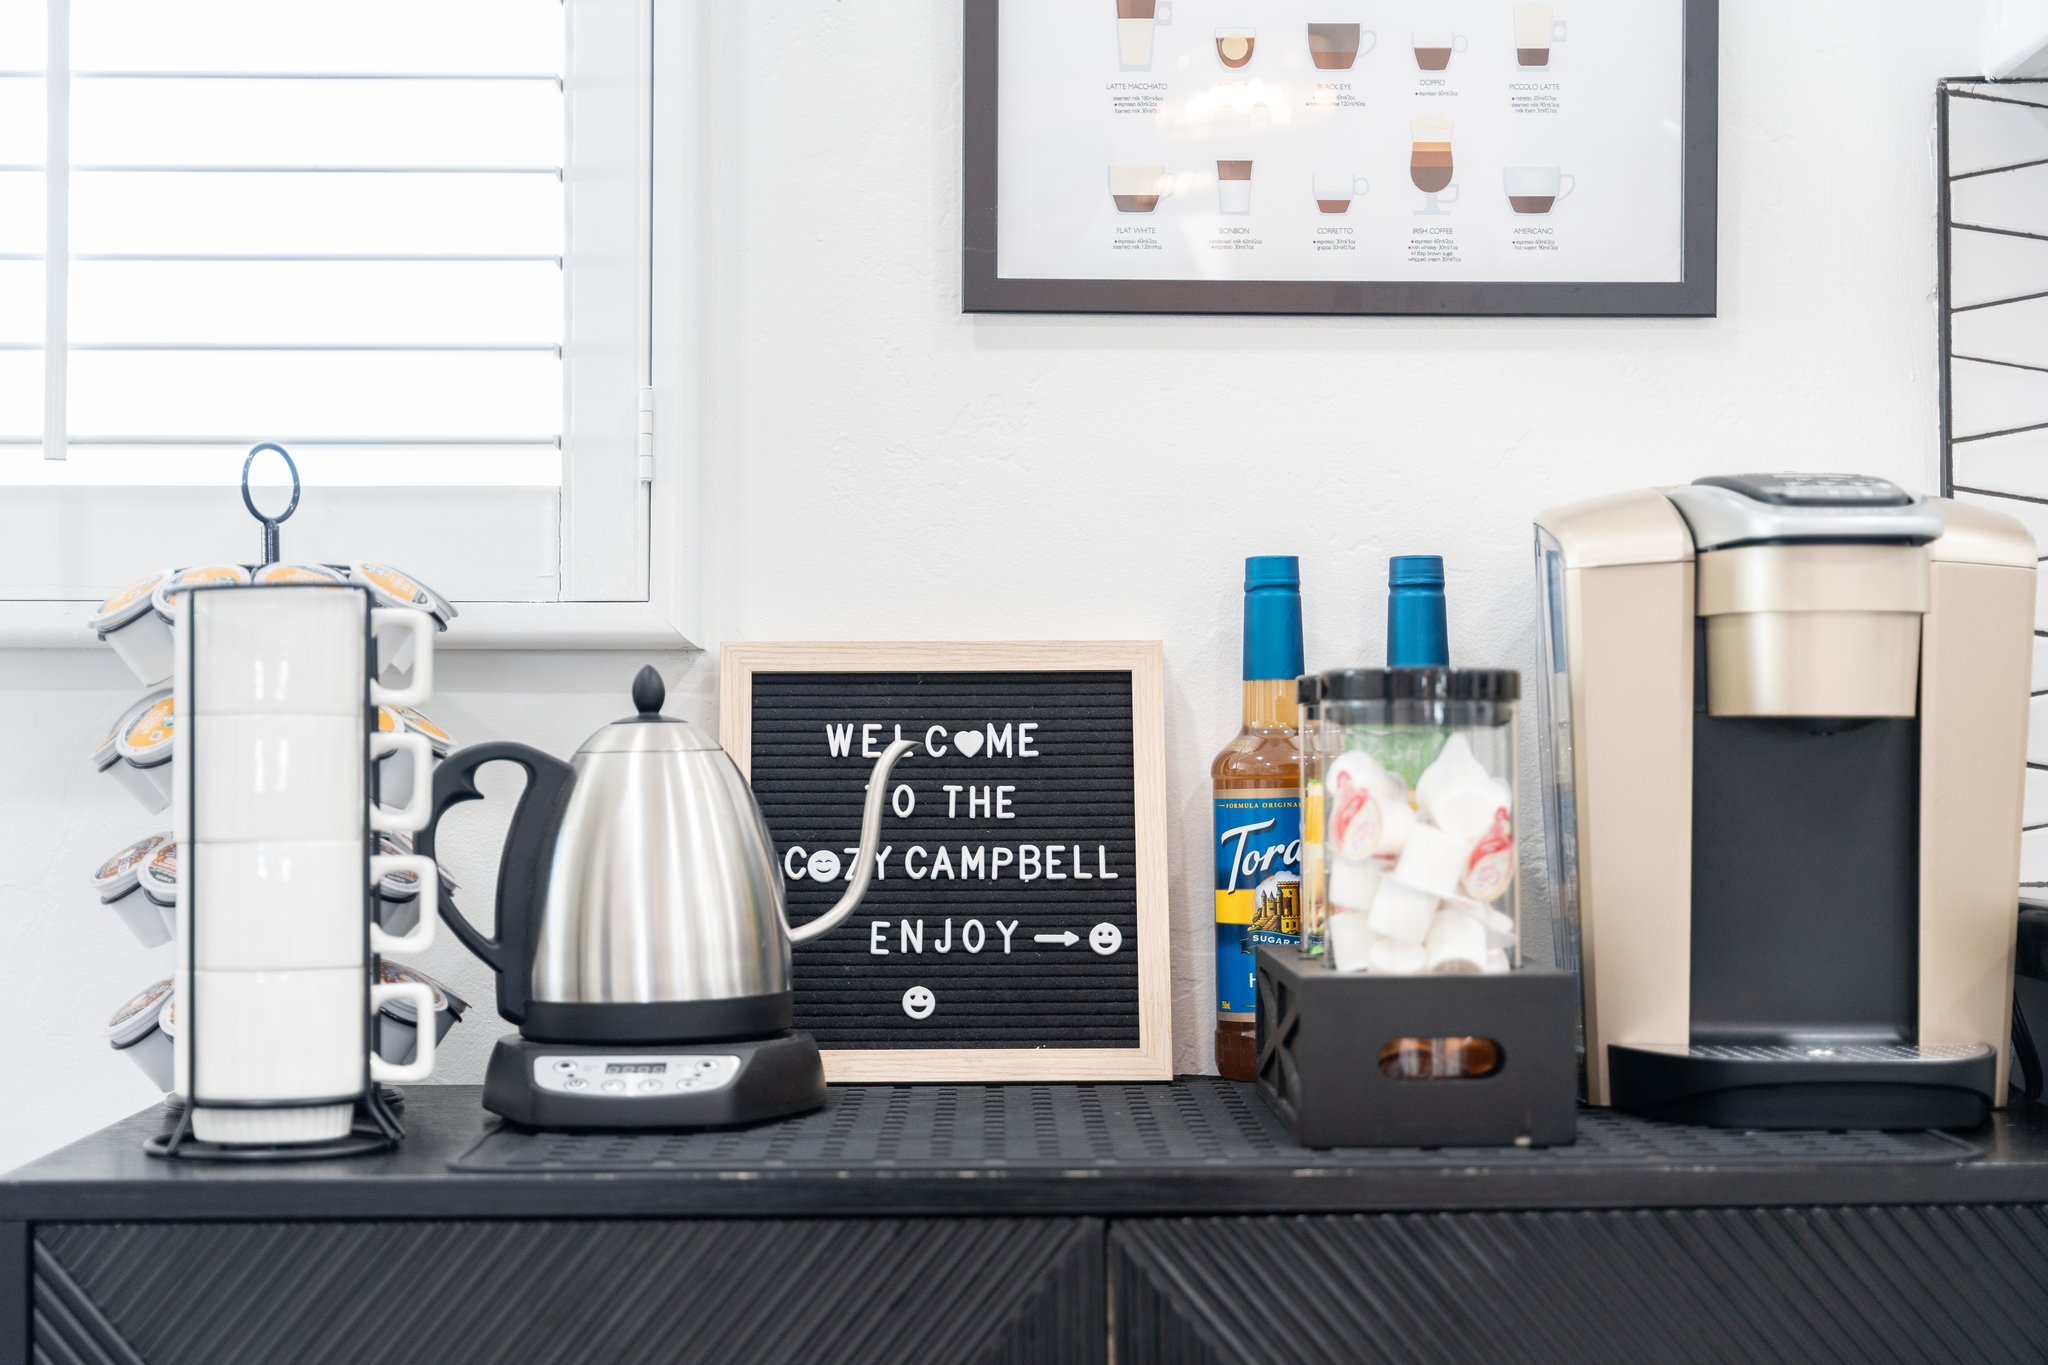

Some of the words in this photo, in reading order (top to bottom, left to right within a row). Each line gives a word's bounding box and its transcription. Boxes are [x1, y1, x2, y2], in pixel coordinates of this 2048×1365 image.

[864, 783, 916, 819] O
[942, 784, 1016, 819] THE
[904, 844, 1119, 881] CAMPBELL
[871, 918, 1019, 956] ENJOY
[1252, 934, 1290, 945] SUGAR
